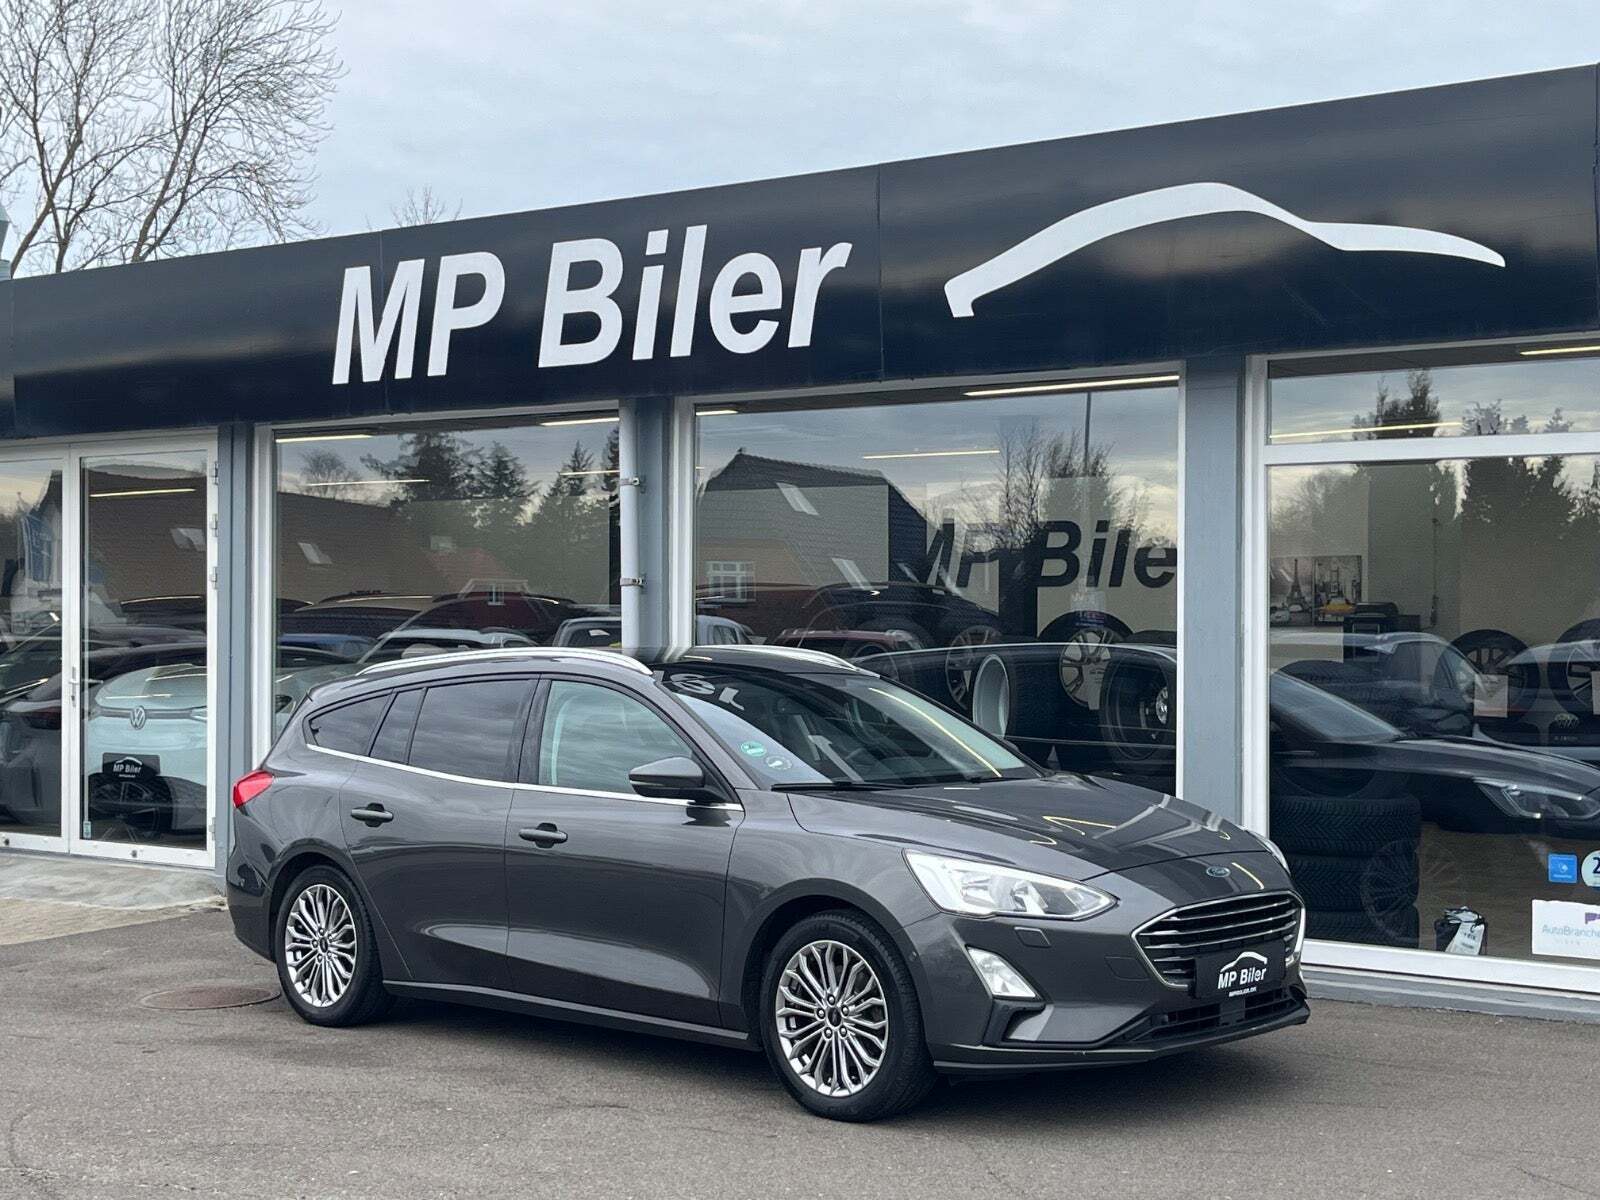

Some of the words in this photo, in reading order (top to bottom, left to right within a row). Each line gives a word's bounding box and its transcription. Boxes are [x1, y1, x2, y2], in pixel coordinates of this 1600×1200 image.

[332, 251, 505, 385] MP
[538, 224, 852, 367] Biler
[1218, 971, 1237, 989] MP
[1240, 967, 1267, 985] Biler
